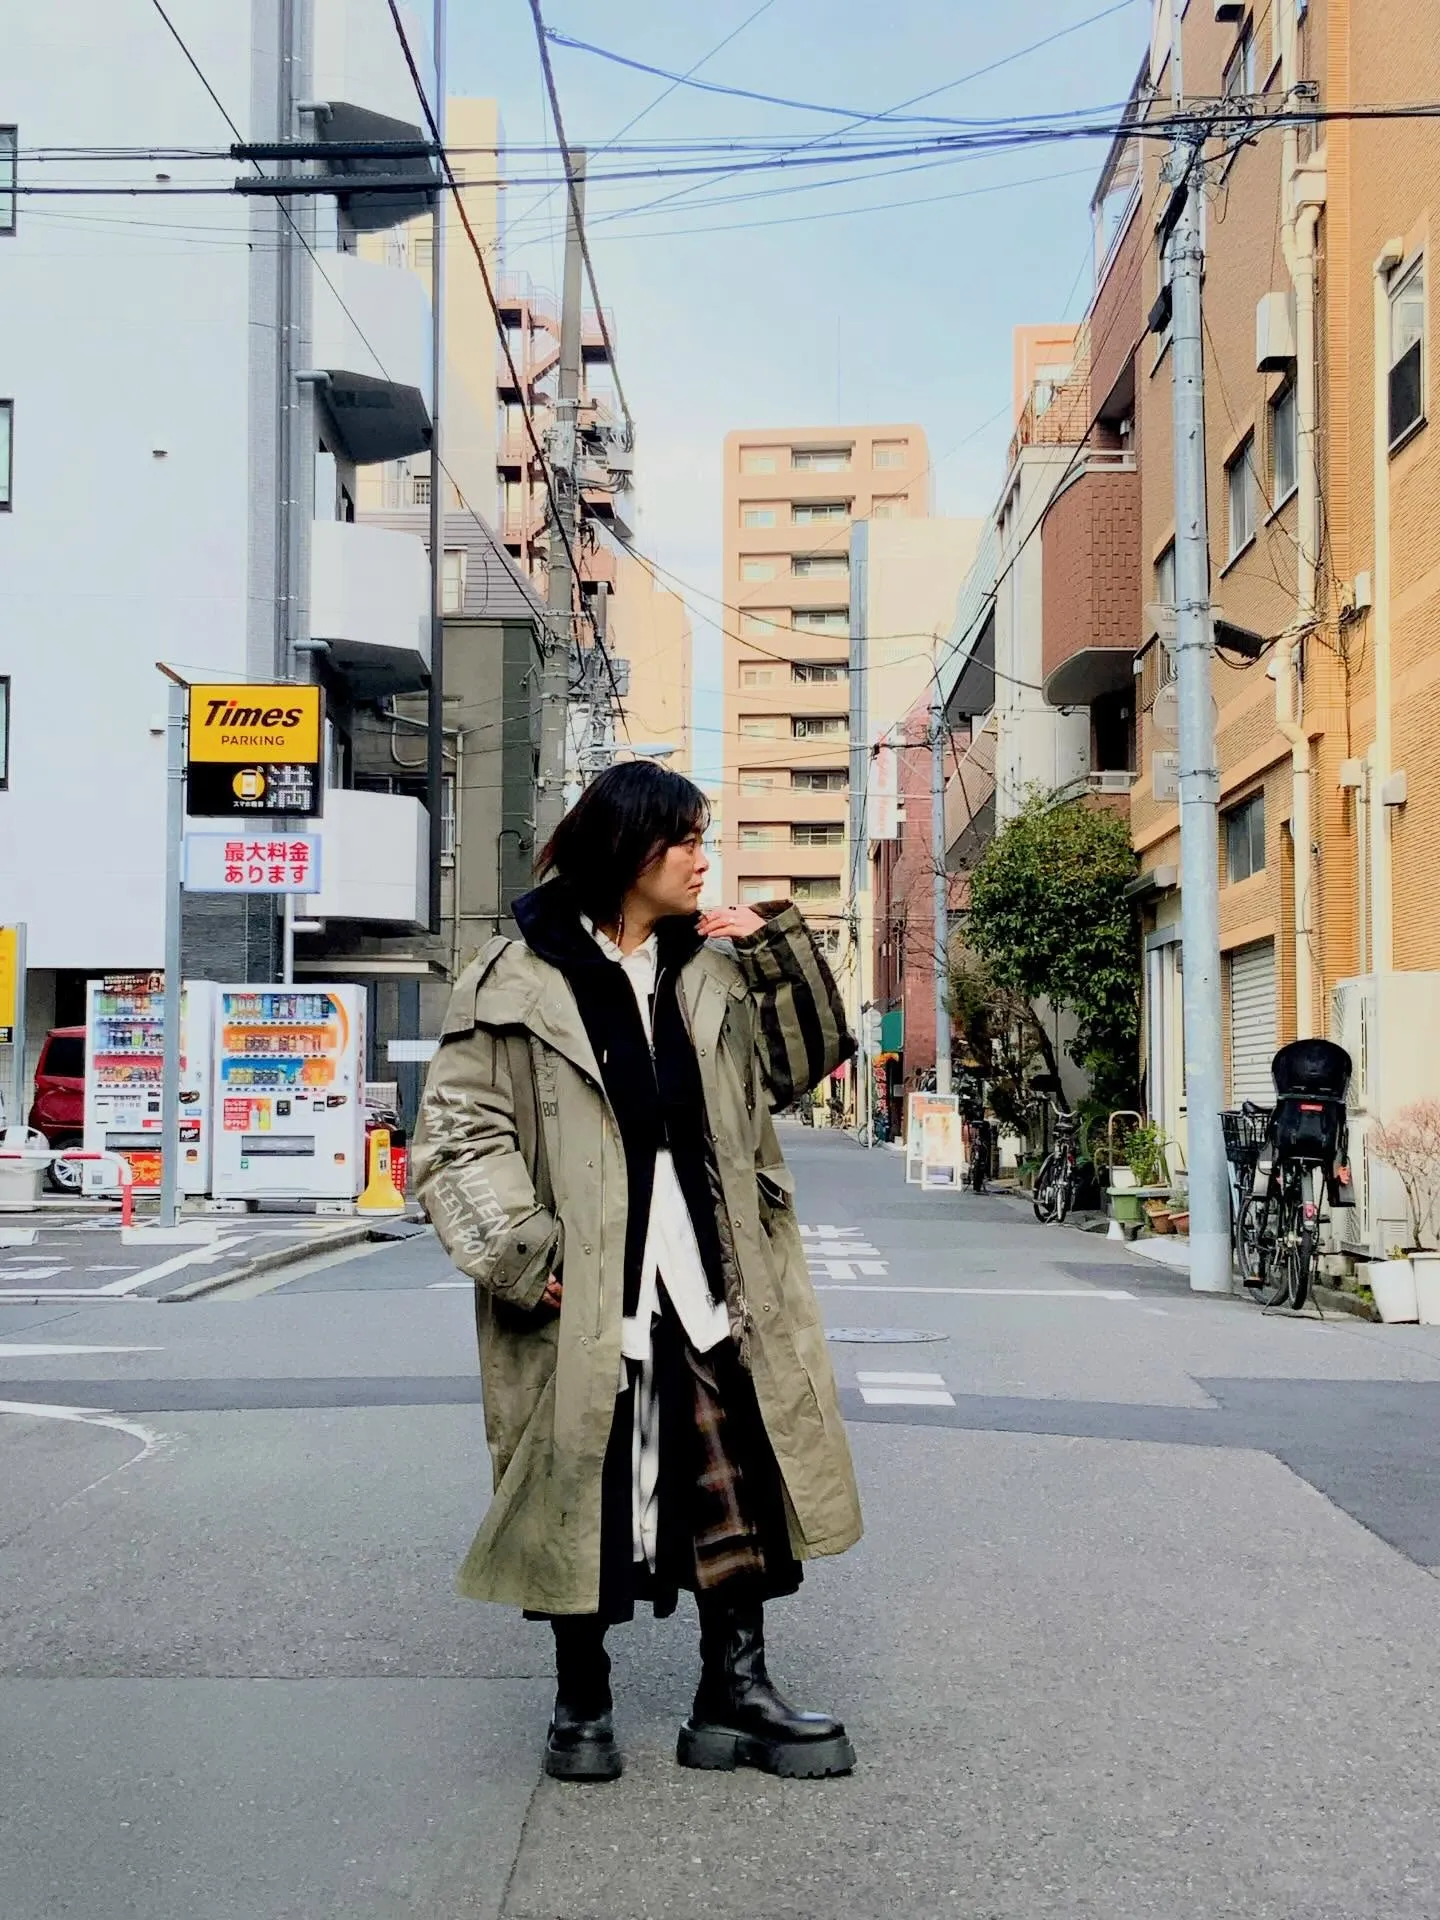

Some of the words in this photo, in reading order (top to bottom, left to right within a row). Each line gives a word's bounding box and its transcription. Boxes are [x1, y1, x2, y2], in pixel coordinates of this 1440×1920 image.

[205, 700, 303, 727] Times
[221, 735, 285, 746] PARKING
[267, 765, 313, 810] 満
[224, 841, 309, 862] 最大料金
[224, 864, 309, 884] あります
[457, 1166, 510, 1240] ALIEN
